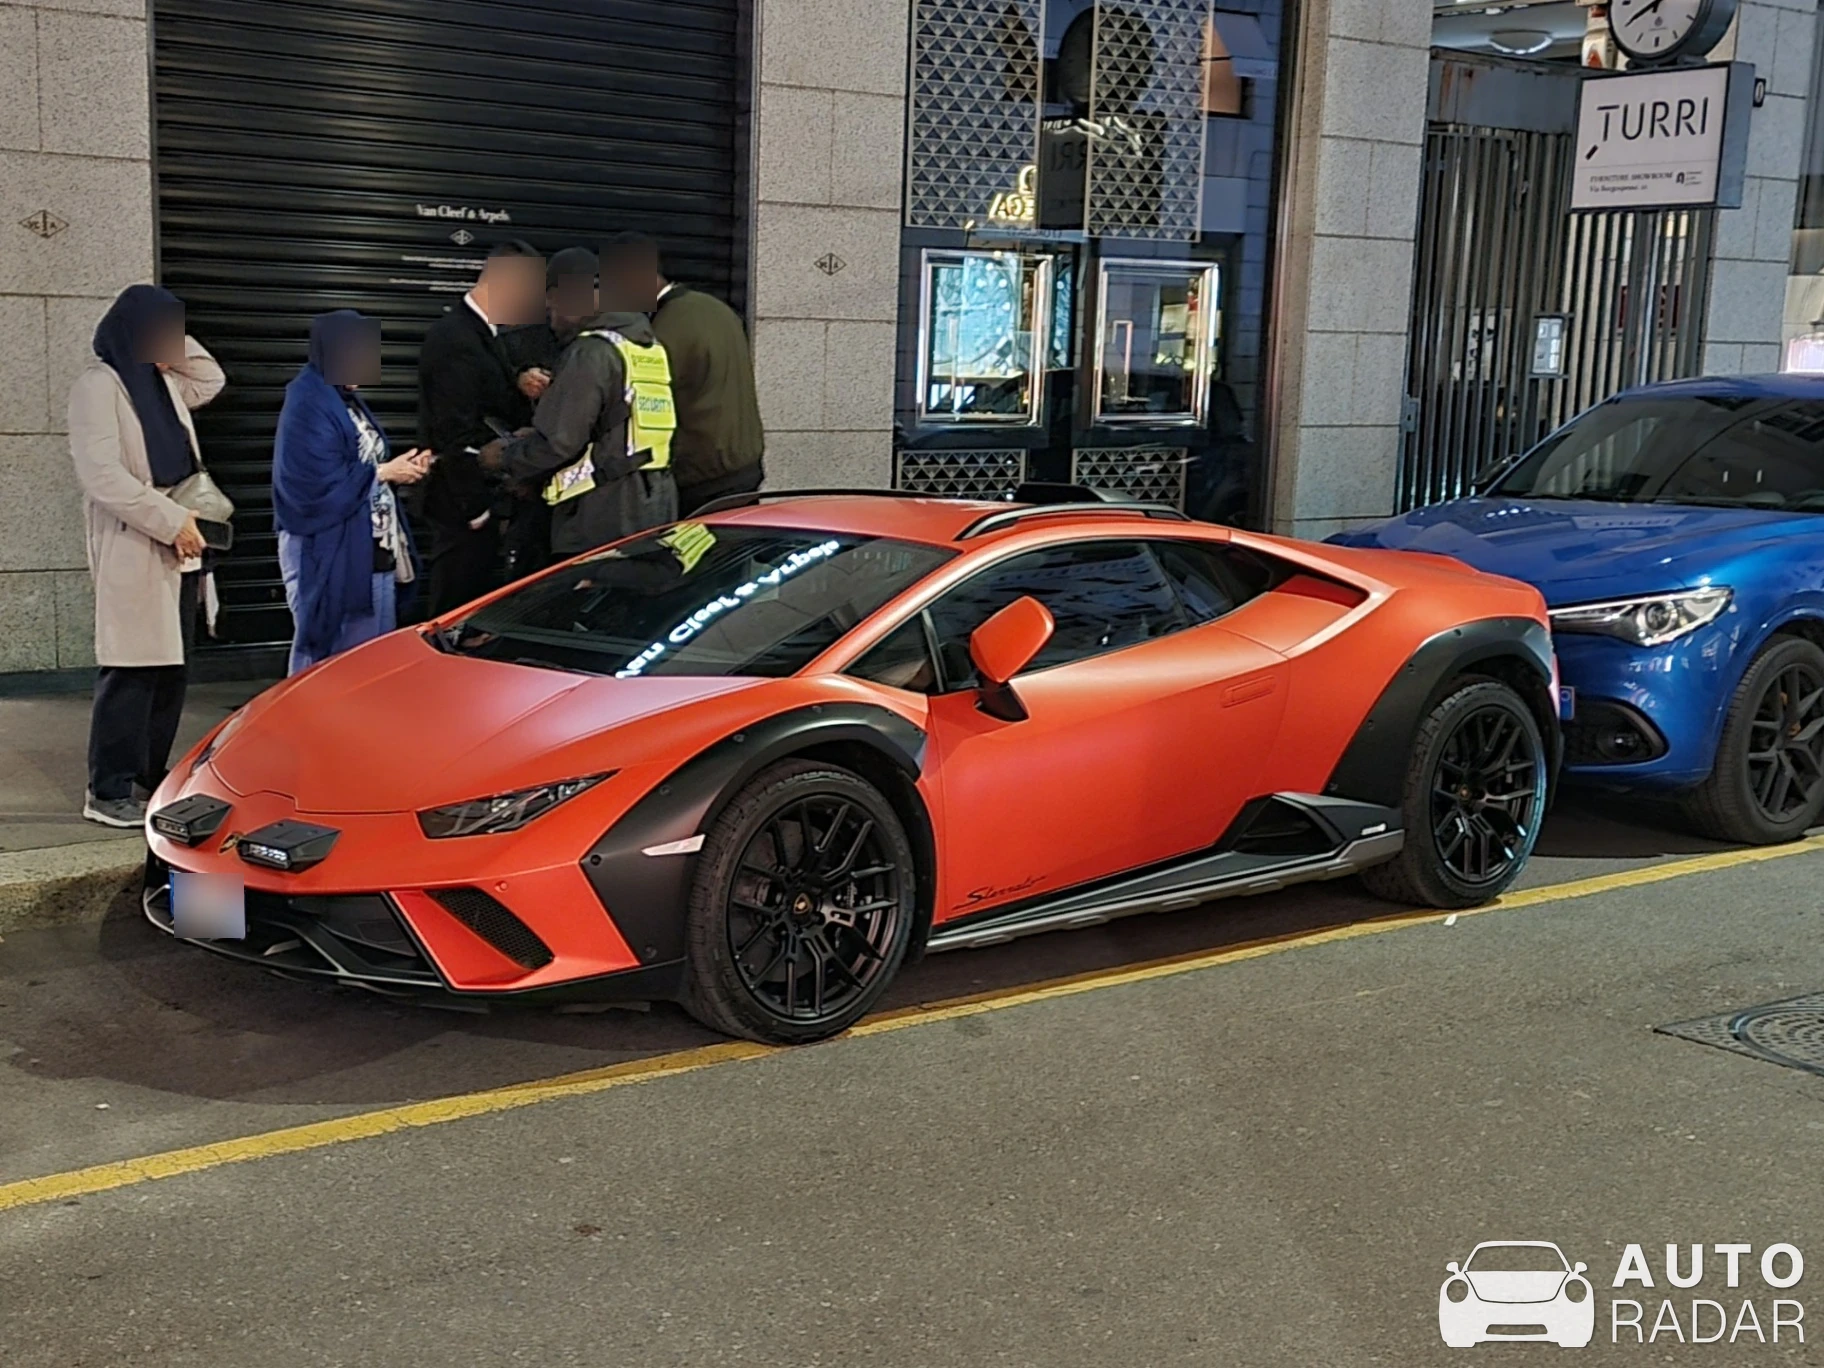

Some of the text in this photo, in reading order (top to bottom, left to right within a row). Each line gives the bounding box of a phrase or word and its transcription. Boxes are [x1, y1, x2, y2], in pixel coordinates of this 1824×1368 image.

[1597, 97, 1709, 142] TURRI
[416, 203, 510, 223] Van Cleef & Arpels
